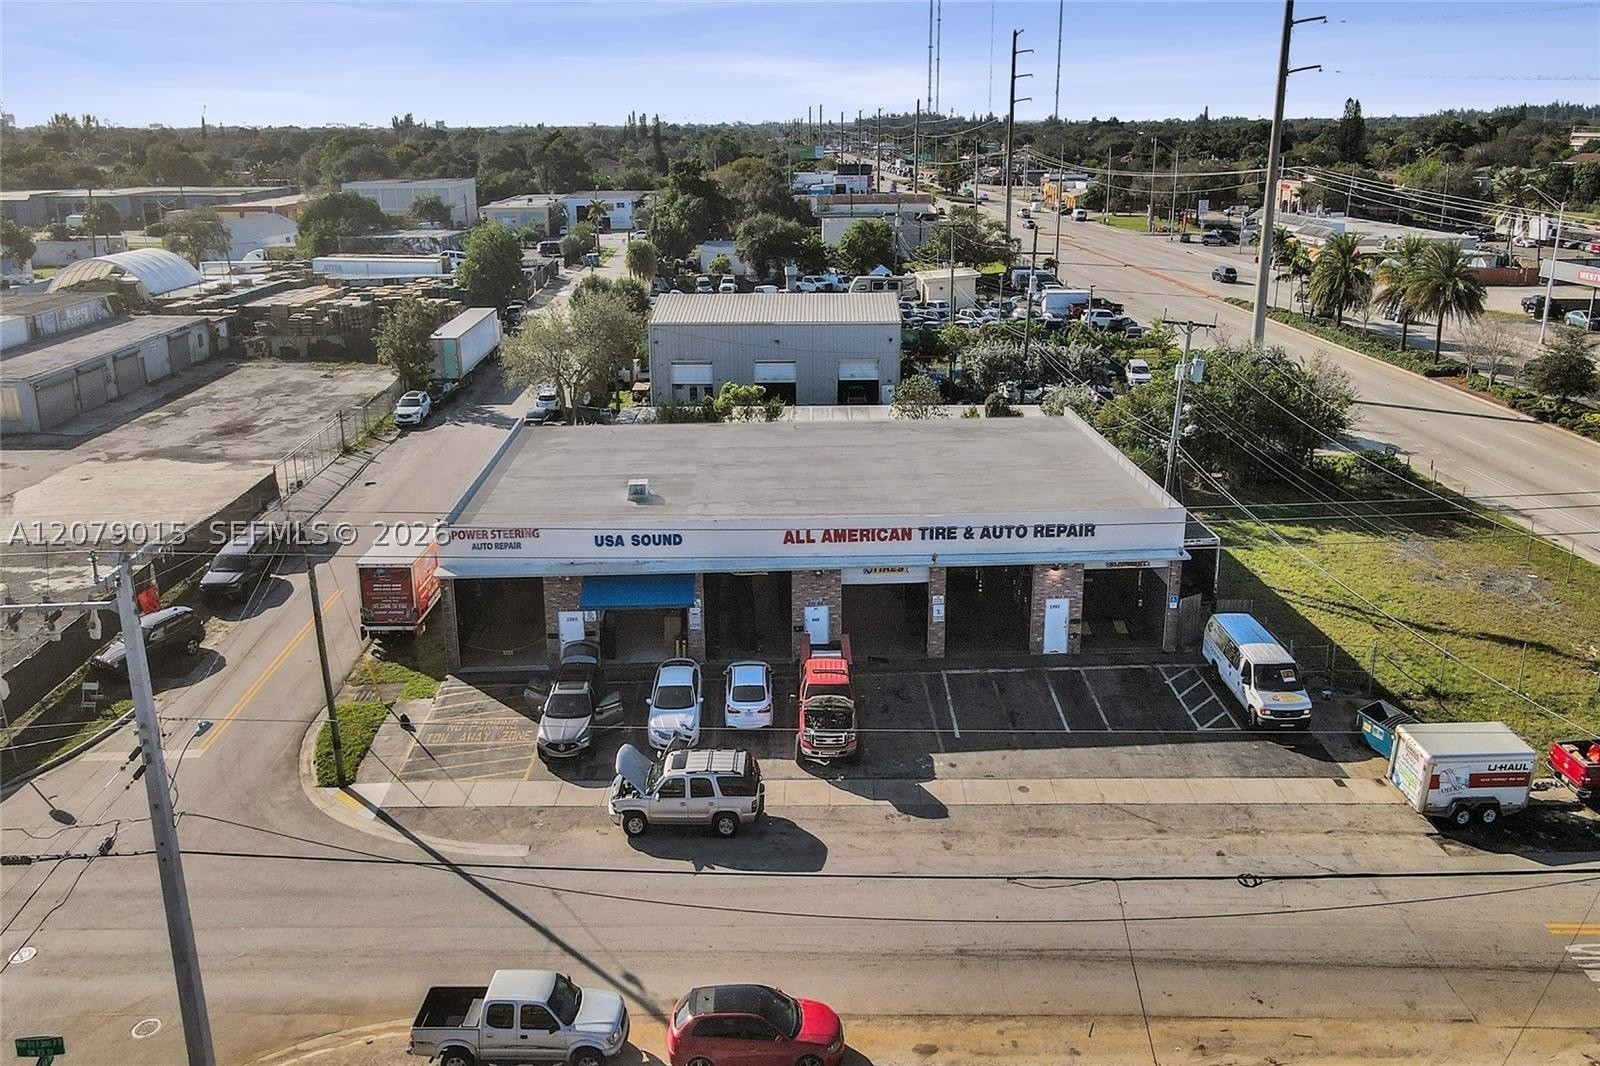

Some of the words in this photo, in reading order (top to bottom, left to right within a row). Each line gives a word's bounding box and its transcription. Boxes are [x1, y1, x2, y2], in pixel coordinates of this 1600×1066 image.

[451, 529, 489, 540] POWER
[490, 528, 540, 539] STEERING
[594, 534, 625, 547] USA
[631, 533, 683, 547] SOUND
[783, 530, 816, 544] ALL
[821, 527, 912, 543] AMERICAN
[918, 526, 958, 541] TIRE
[963, 526, 975, 540] &
[980, 524, 1028, 539] AUTO
[1033, 523, 1097, 539] REPAIR
[472, 542, 493, 550] AUTO
[494, 542, 522, 550] REPAIR
[447, 719, 465, 732] NO
[468, 719, 520, 732] PARKING
[427, 732, 450, 743] TOW
[460, 731, 492, 742] AWAY
[500, 730, 534, 741] ZONE
[1488, 763, 1529, 771] U-HAUL
